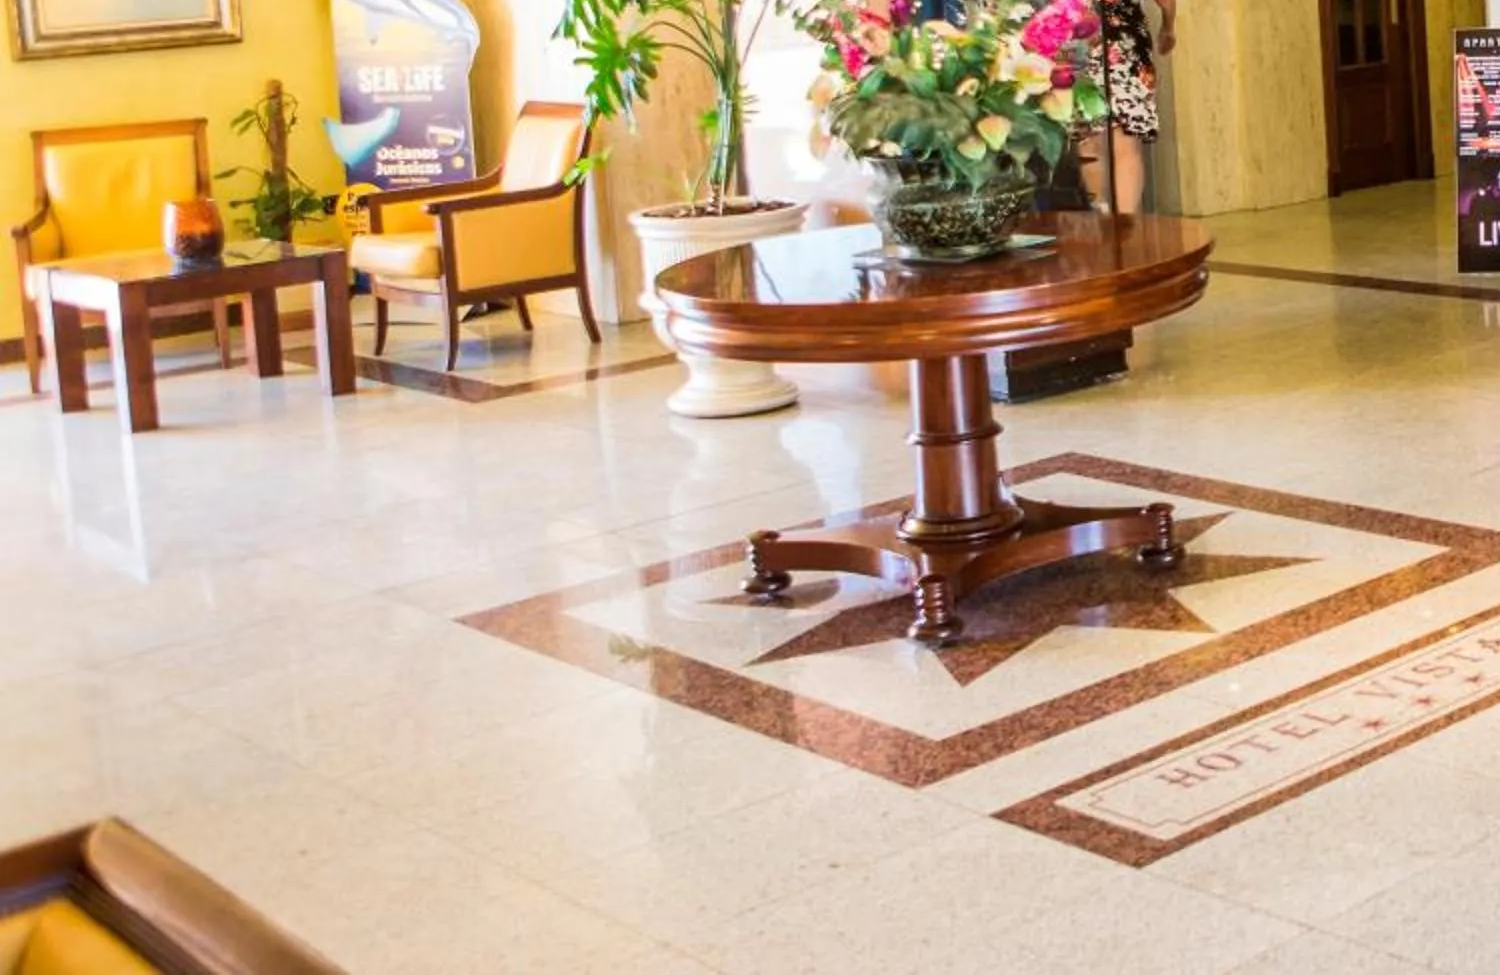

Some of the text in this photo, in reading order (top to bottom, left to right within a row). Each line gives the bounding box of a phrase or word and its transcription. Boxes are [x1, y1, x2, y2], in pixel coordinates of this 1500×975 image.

[356, 65, 446, 93] SEA LIFE
[1156, 710, 1349, 789] HOTEL
